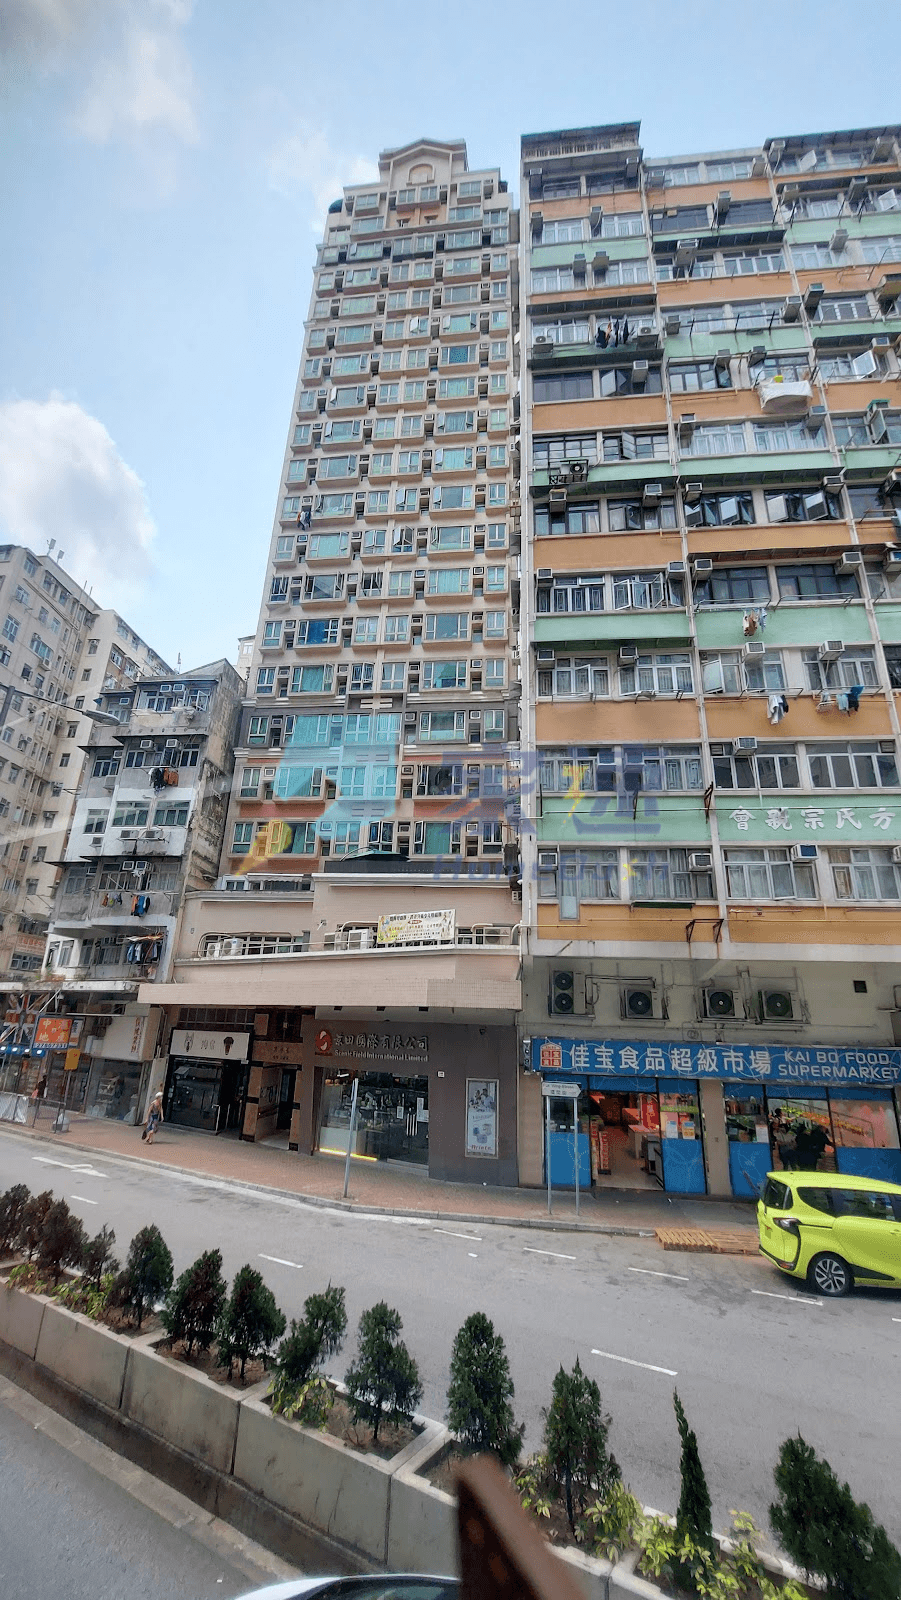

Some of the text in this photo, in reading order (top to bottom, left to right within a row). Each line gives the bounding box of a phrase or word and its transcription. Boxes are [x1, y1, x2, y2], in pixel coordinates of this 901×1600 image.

[784, 1050, 890, 1065] KAI BO FOOD
[778, 1064, 899, 1079] SUPERMARKET
